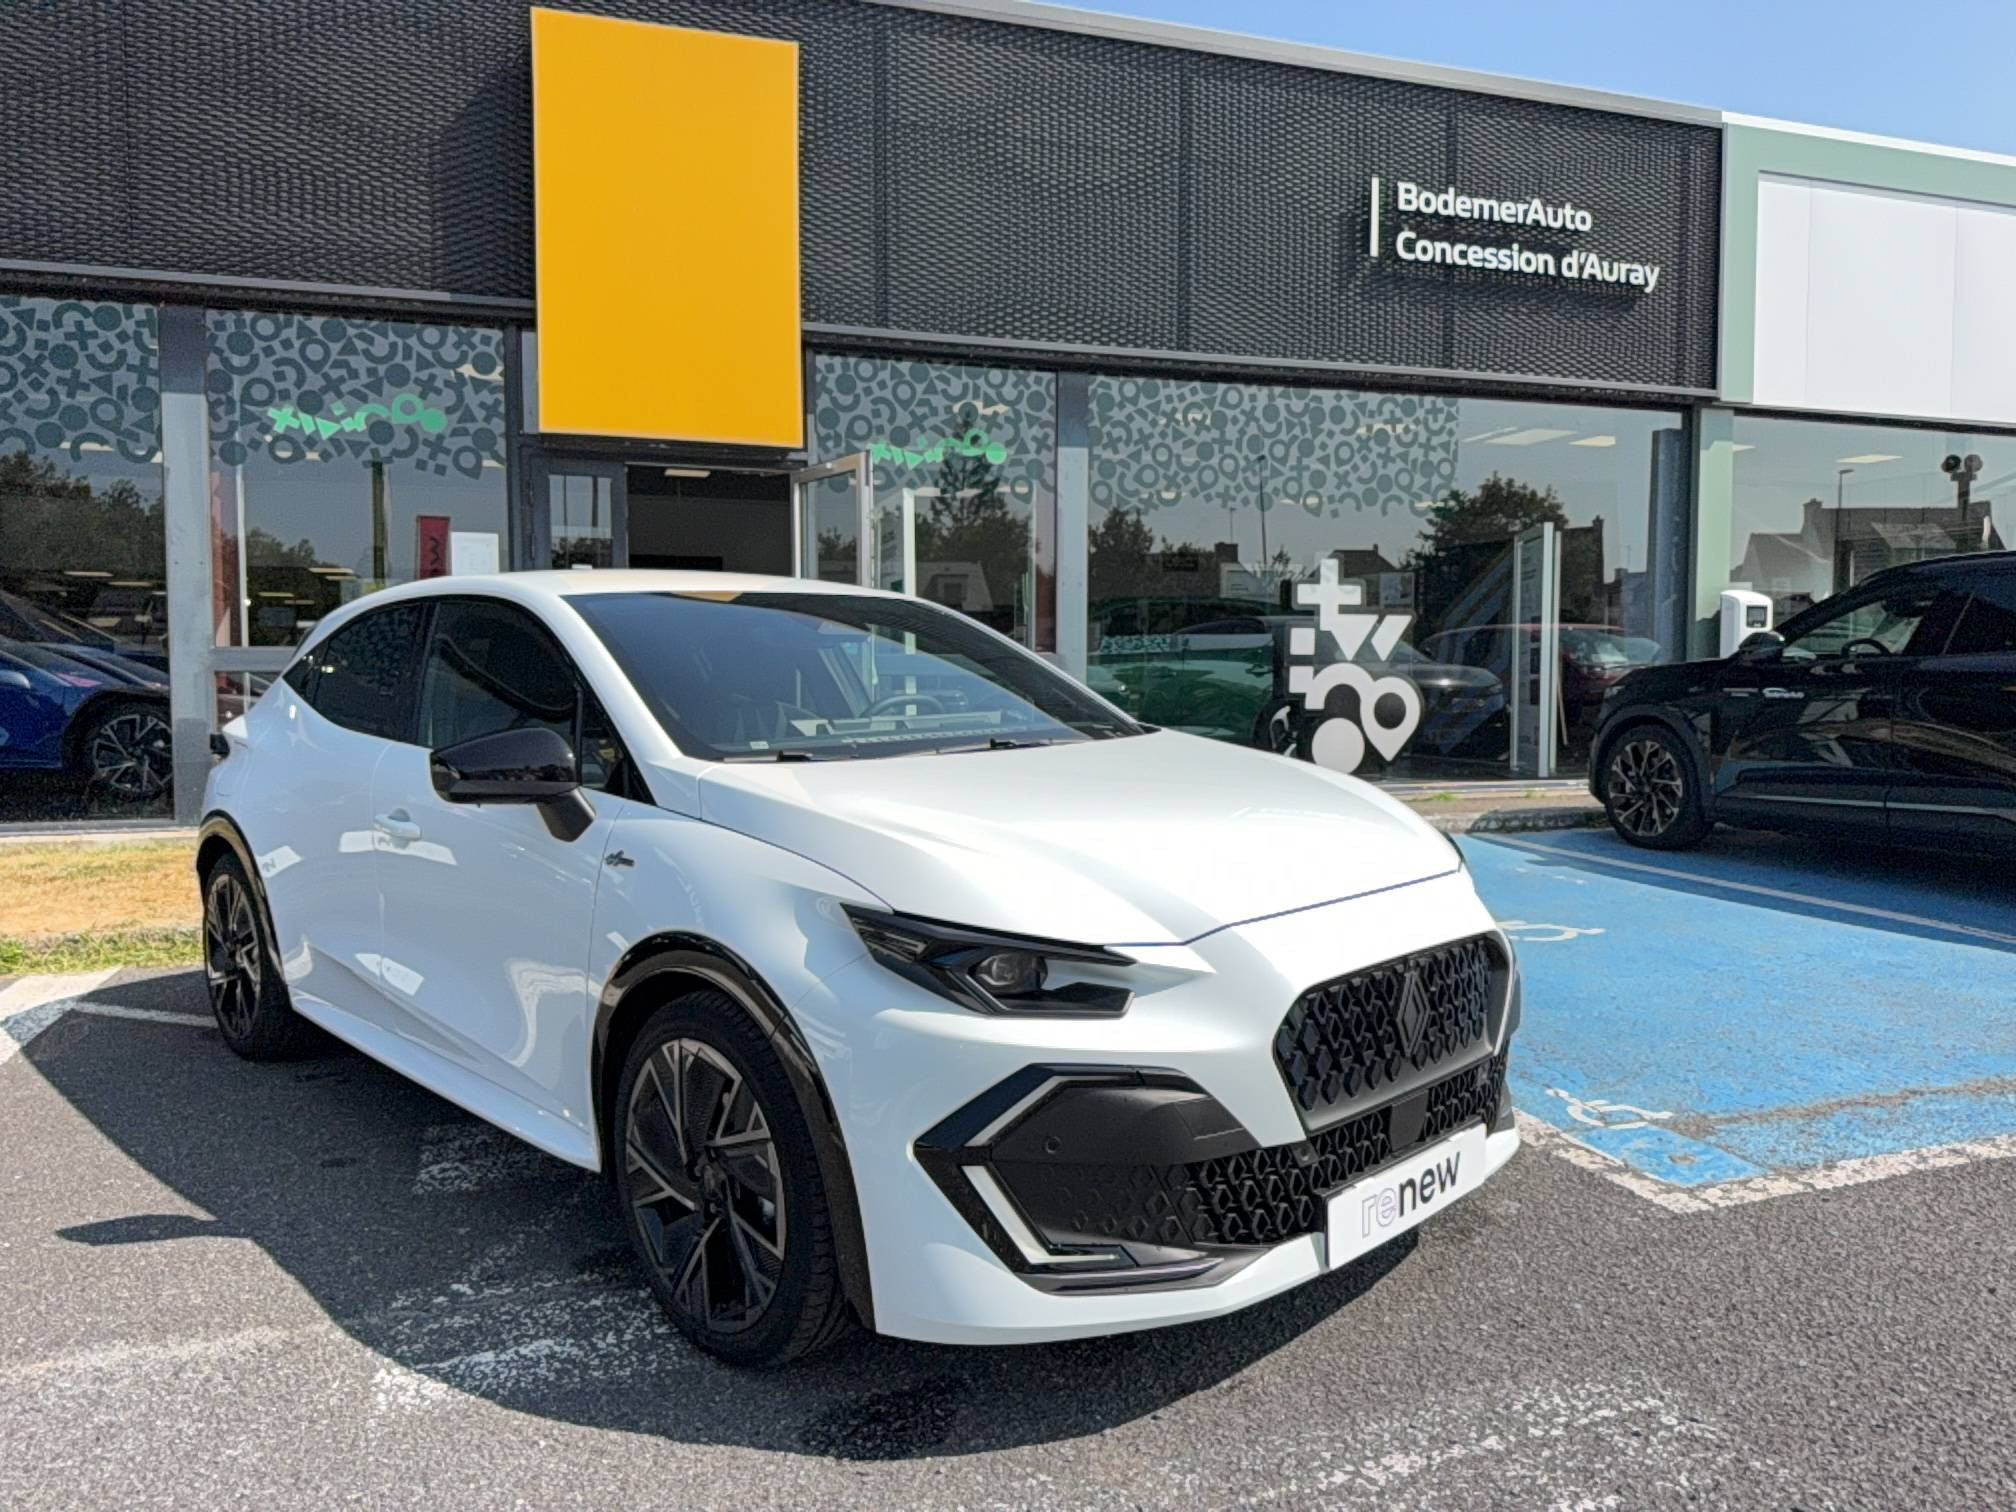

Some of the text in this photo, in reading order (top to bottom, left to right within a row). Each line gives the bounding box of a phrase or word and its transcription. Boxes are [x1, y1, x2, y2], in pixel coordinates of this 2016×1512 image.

[1397, 181, 1592, 231] BodemerAuto
[1396, 231, 1660, 292] Concession d'Auray
[1361, 1151, 1461, 1239] renew
